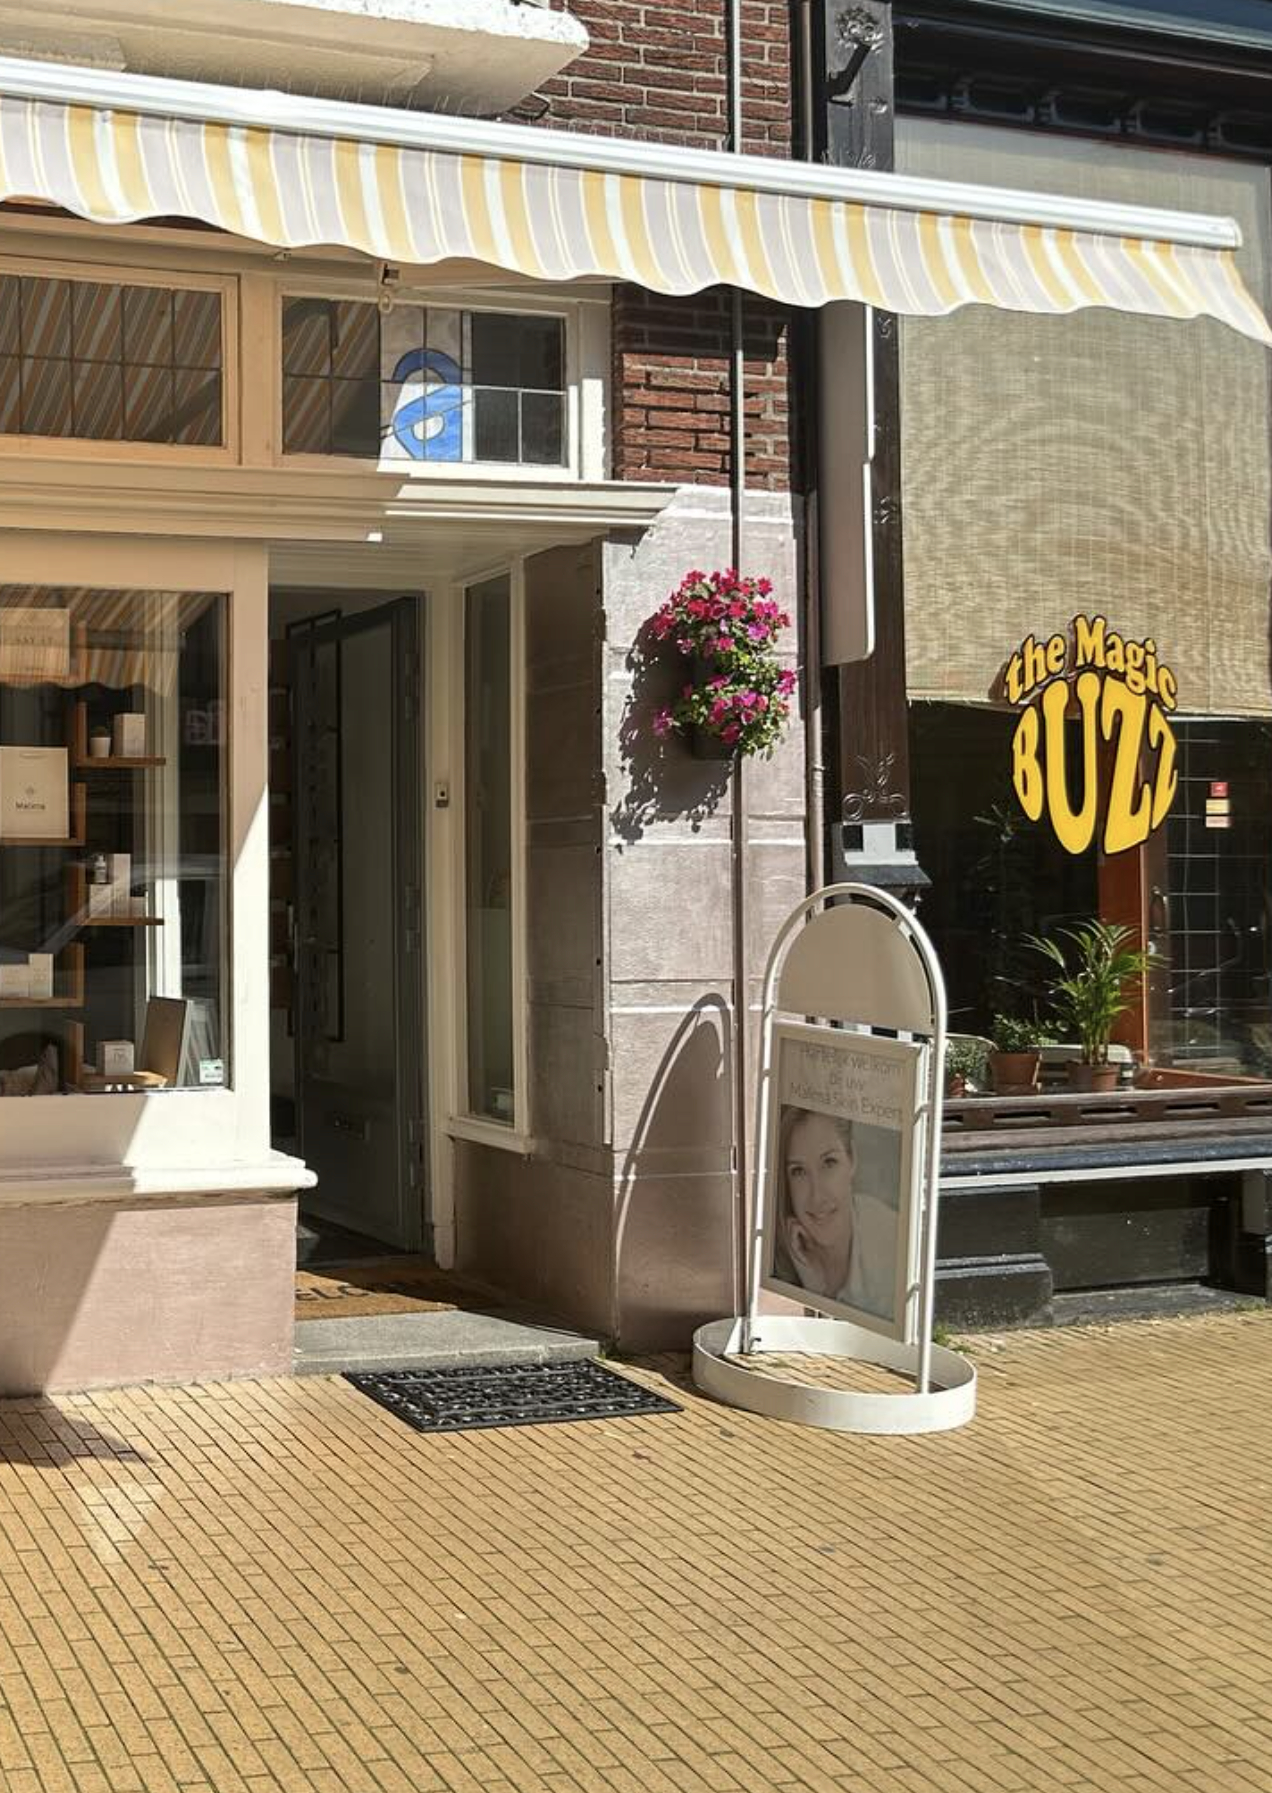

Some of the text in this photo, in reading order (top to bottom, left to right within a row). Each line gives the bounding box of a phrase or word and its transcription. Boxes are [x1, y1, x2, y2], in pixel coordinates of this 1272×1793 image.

[1004, 613, 1178, 712] the Magic
[1011, 671, 1178, 855] BUZZ
